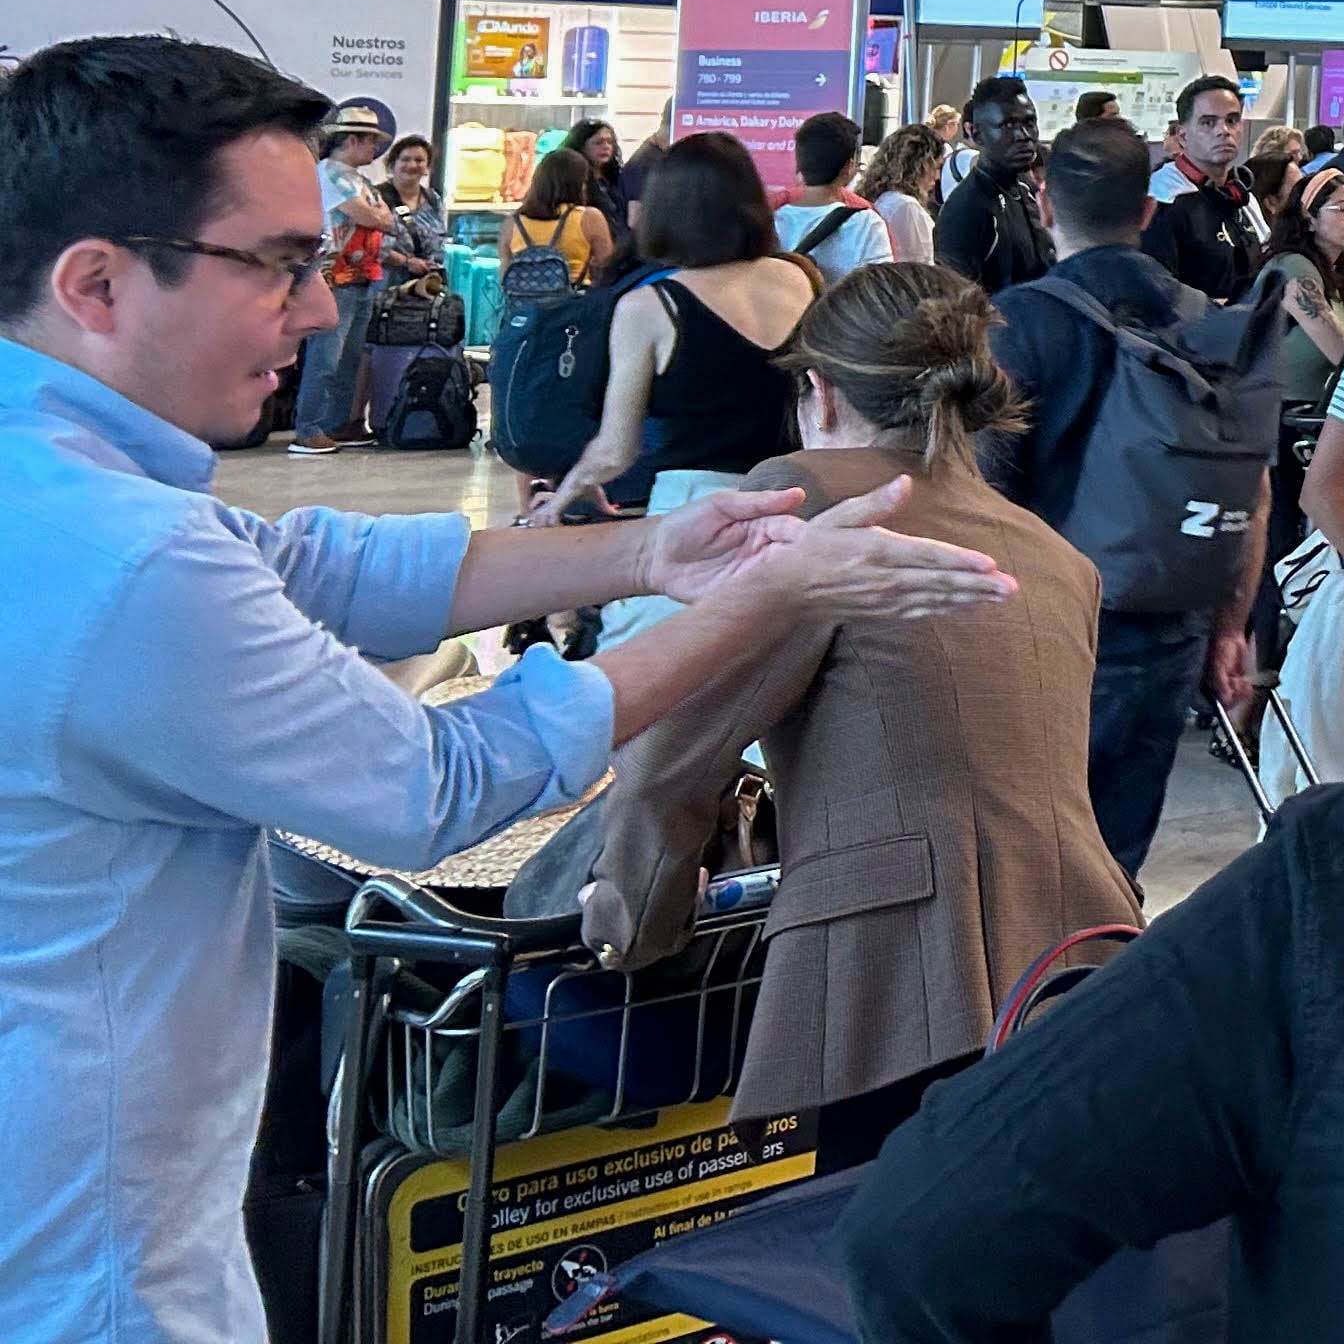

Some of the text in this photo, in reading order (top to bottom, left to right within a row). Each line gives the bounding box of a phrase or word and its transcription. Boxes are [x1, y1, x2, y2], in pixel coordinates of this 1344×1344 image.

[755, 11, 808, 23] IBERIA
[333, 35, 405, 50] Nuestros
[331, 51, 404, 66] Servicios
[699, 55, 741, 67] Business
[330, 67, 403, 80] Our Services
[723, 73, 741, 84] 799
[517, 1176, 559, 1198] para
[566, 1166, 598, 1182] uso
[604, 1143, 685, 1177] exclusivo
[690, 1136, 713, 1154] de
[535, 1199, 558, 1217] for
[564, 1177, 640, 1209] exclusive
[644, 1173, 674, 1190] use
[678, 1163, 694, 1181] of
[699, 1141, 785, 1178] passeers
[507, 1239, 523, 1250] DE
[526, 1232, 550, 1248] USO
[553, 1227, 568, 1239] EN
[571, 1214, 616, 1235] RAMPAS
[494, 1259, 545, 1283] trayecto
[654, 1225, 666, 1239] Al
[669, 1217, 695, 1235] final
[697, 1214, 712, 1228] de
[487, 1278, 534, 1301] passage
